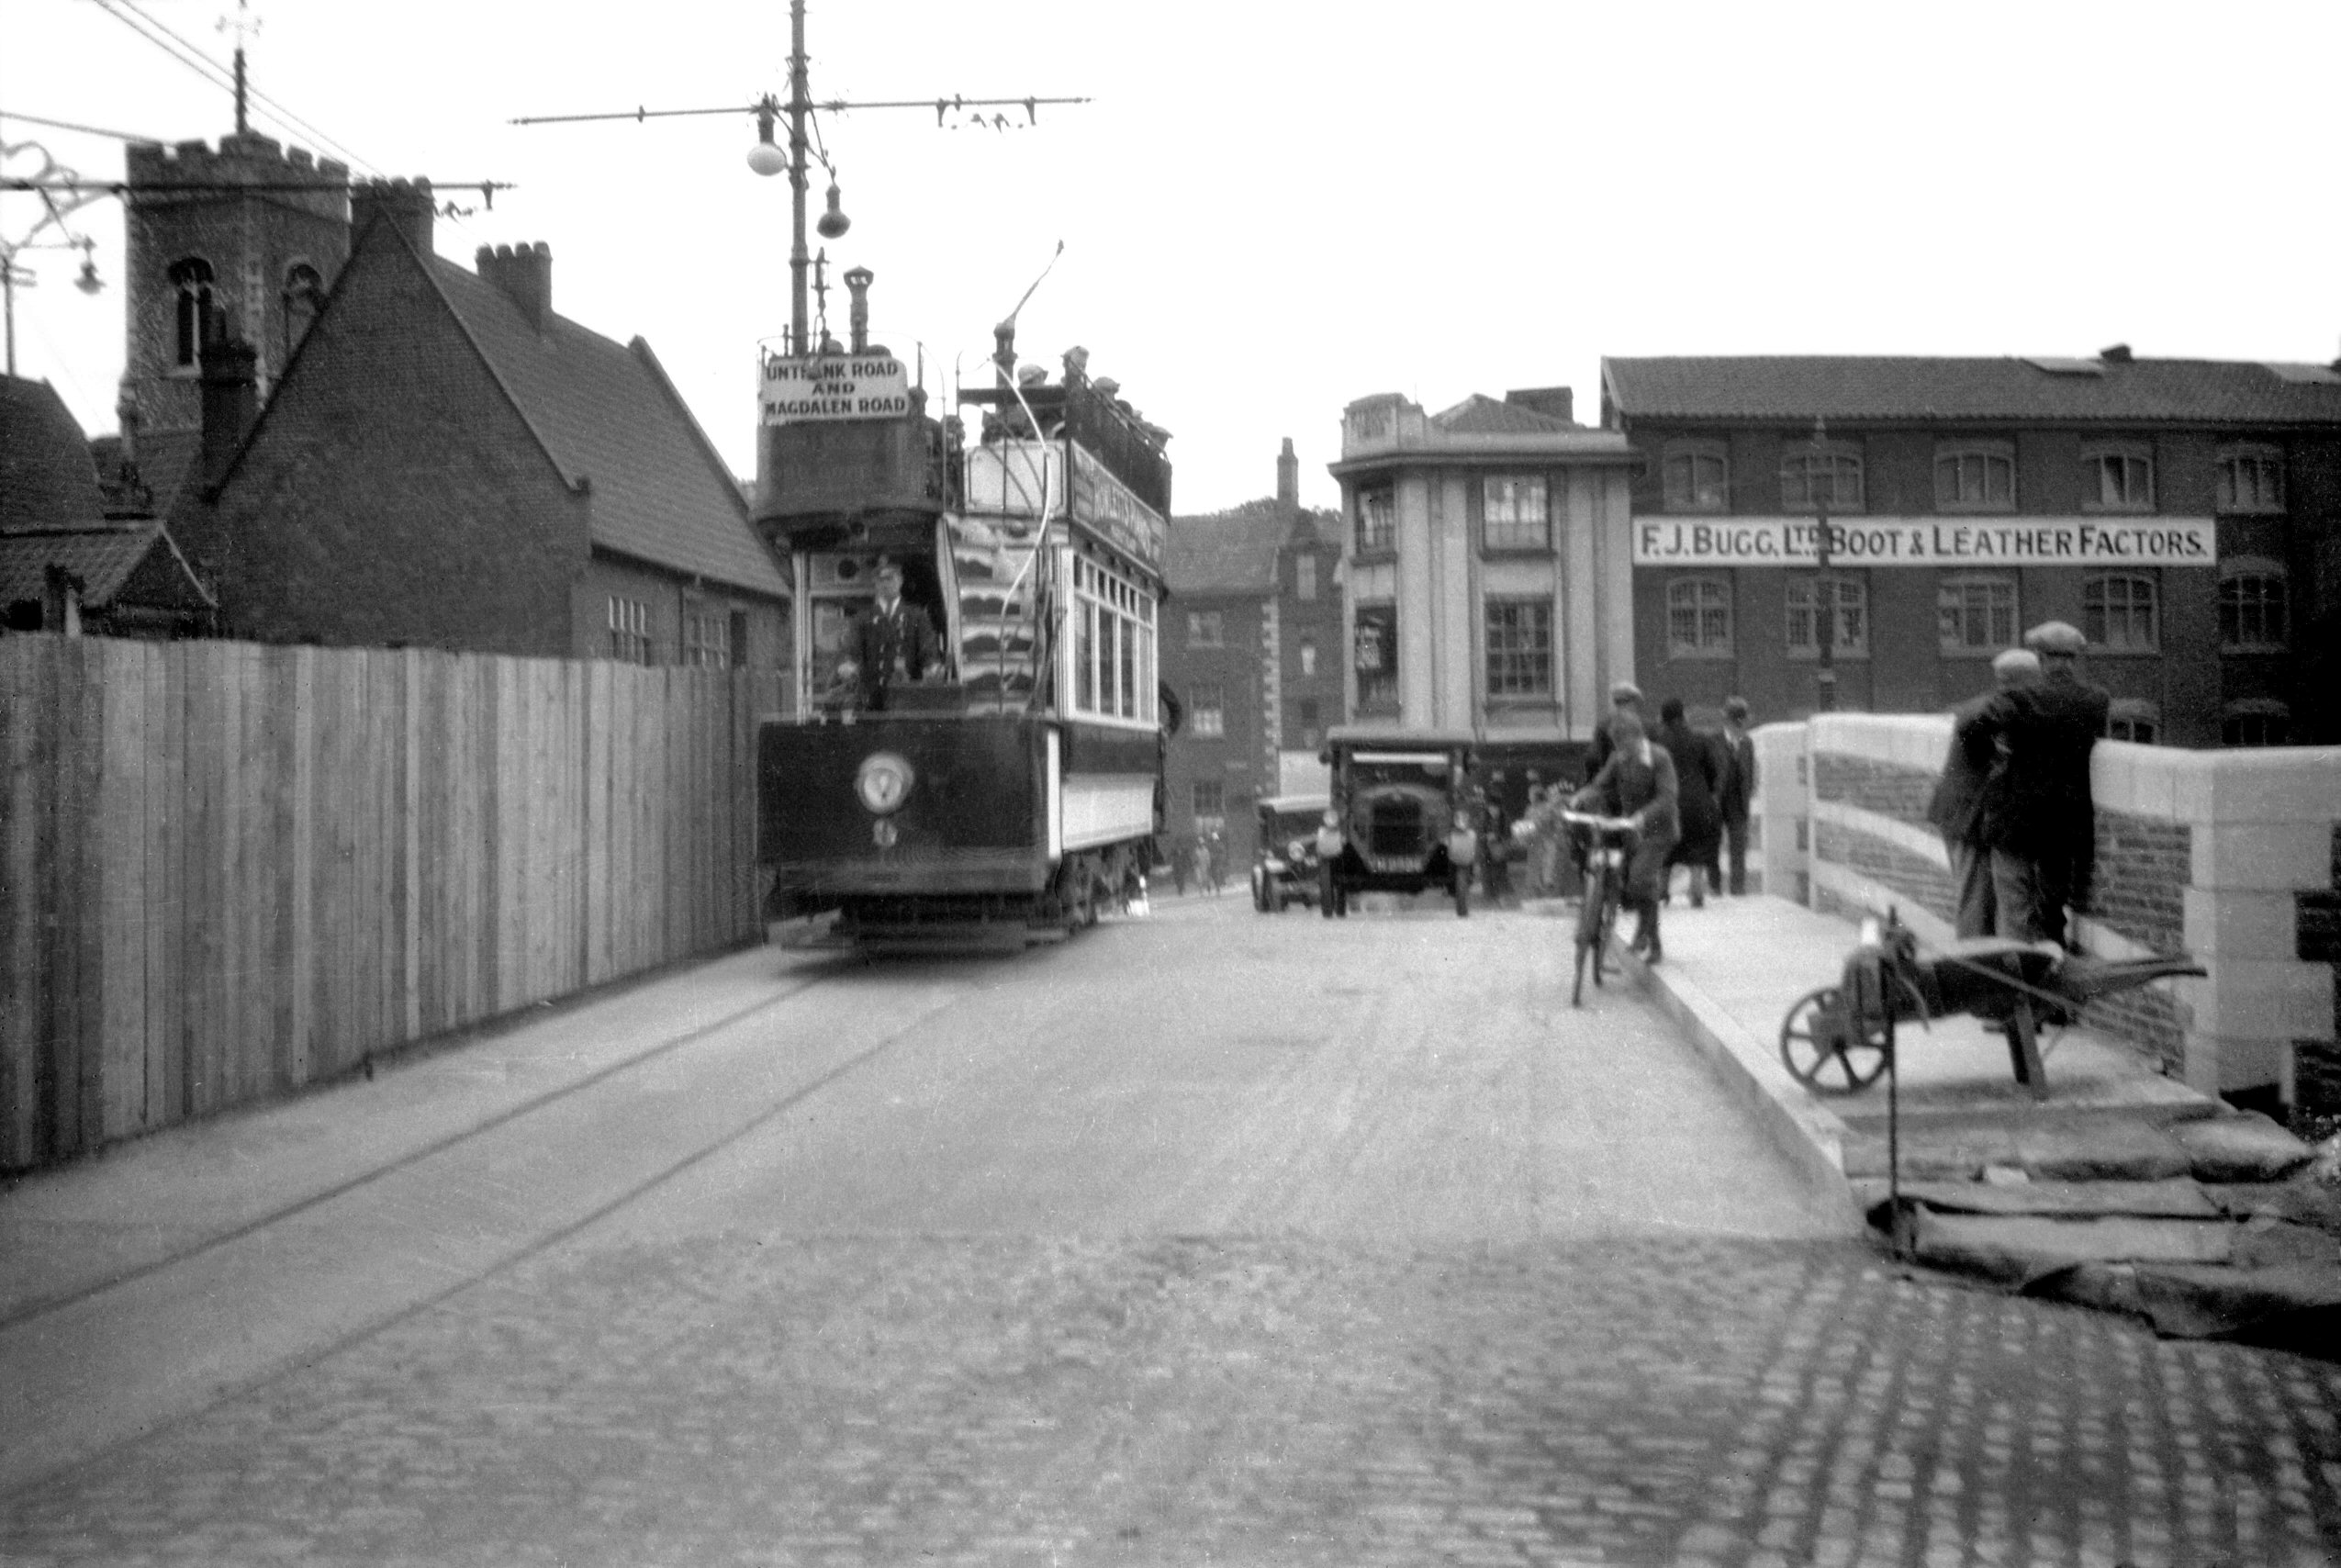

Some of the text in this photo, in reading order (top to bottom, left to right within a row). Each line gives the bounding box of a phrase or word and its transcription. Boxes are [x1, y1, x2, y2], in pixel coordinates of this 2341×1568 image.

[767, 362, 898, 380] UNTHNK ROAD
[812, 382, 855, 395] AND
[766, 397, 905, 415] MAGDALEN ROAD
[1829, 524, 1902, 555] BOOT
[1910, 529, 1924, 556] &
[1932, 524, 2071, 556] LEATHER
